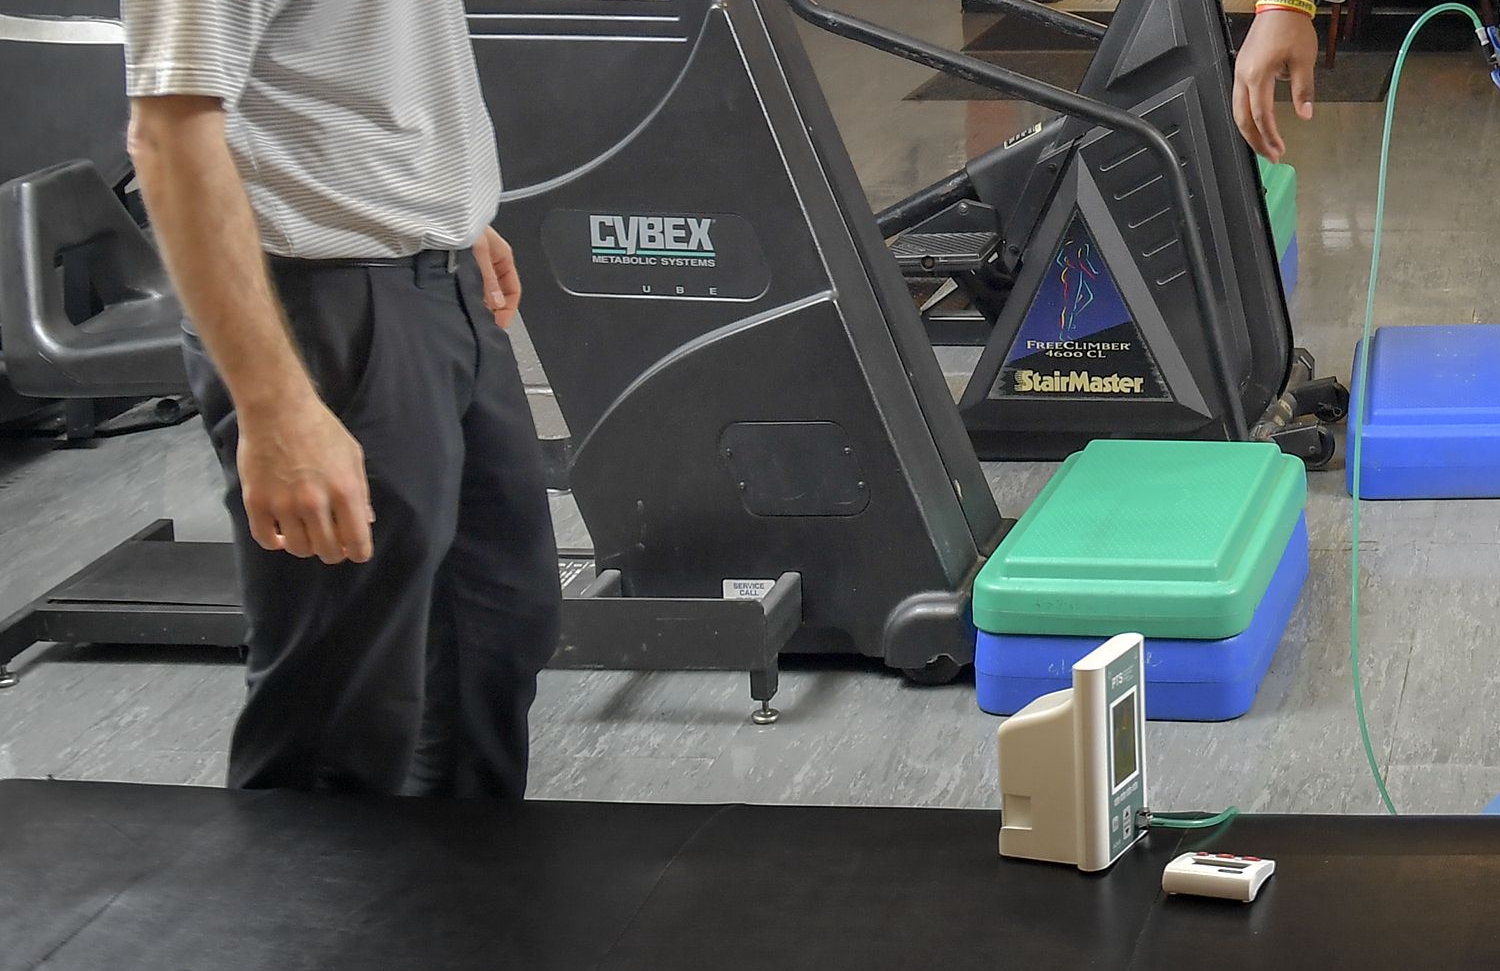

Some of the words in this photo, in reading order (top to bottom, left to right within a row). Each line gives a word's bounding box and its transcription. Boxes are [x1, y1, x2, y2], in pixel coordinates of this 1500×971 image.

[589, 215, 714, 255] CYBEX
[592, 256, 657, 266] METABOLIC
[661, 257, 716, 268] SYSTEMS
[1045, 350, 1083, 358] 4600
[1086, 350, 1106, 359] CL
[1014, 370, 1144, 393] StairMaster
